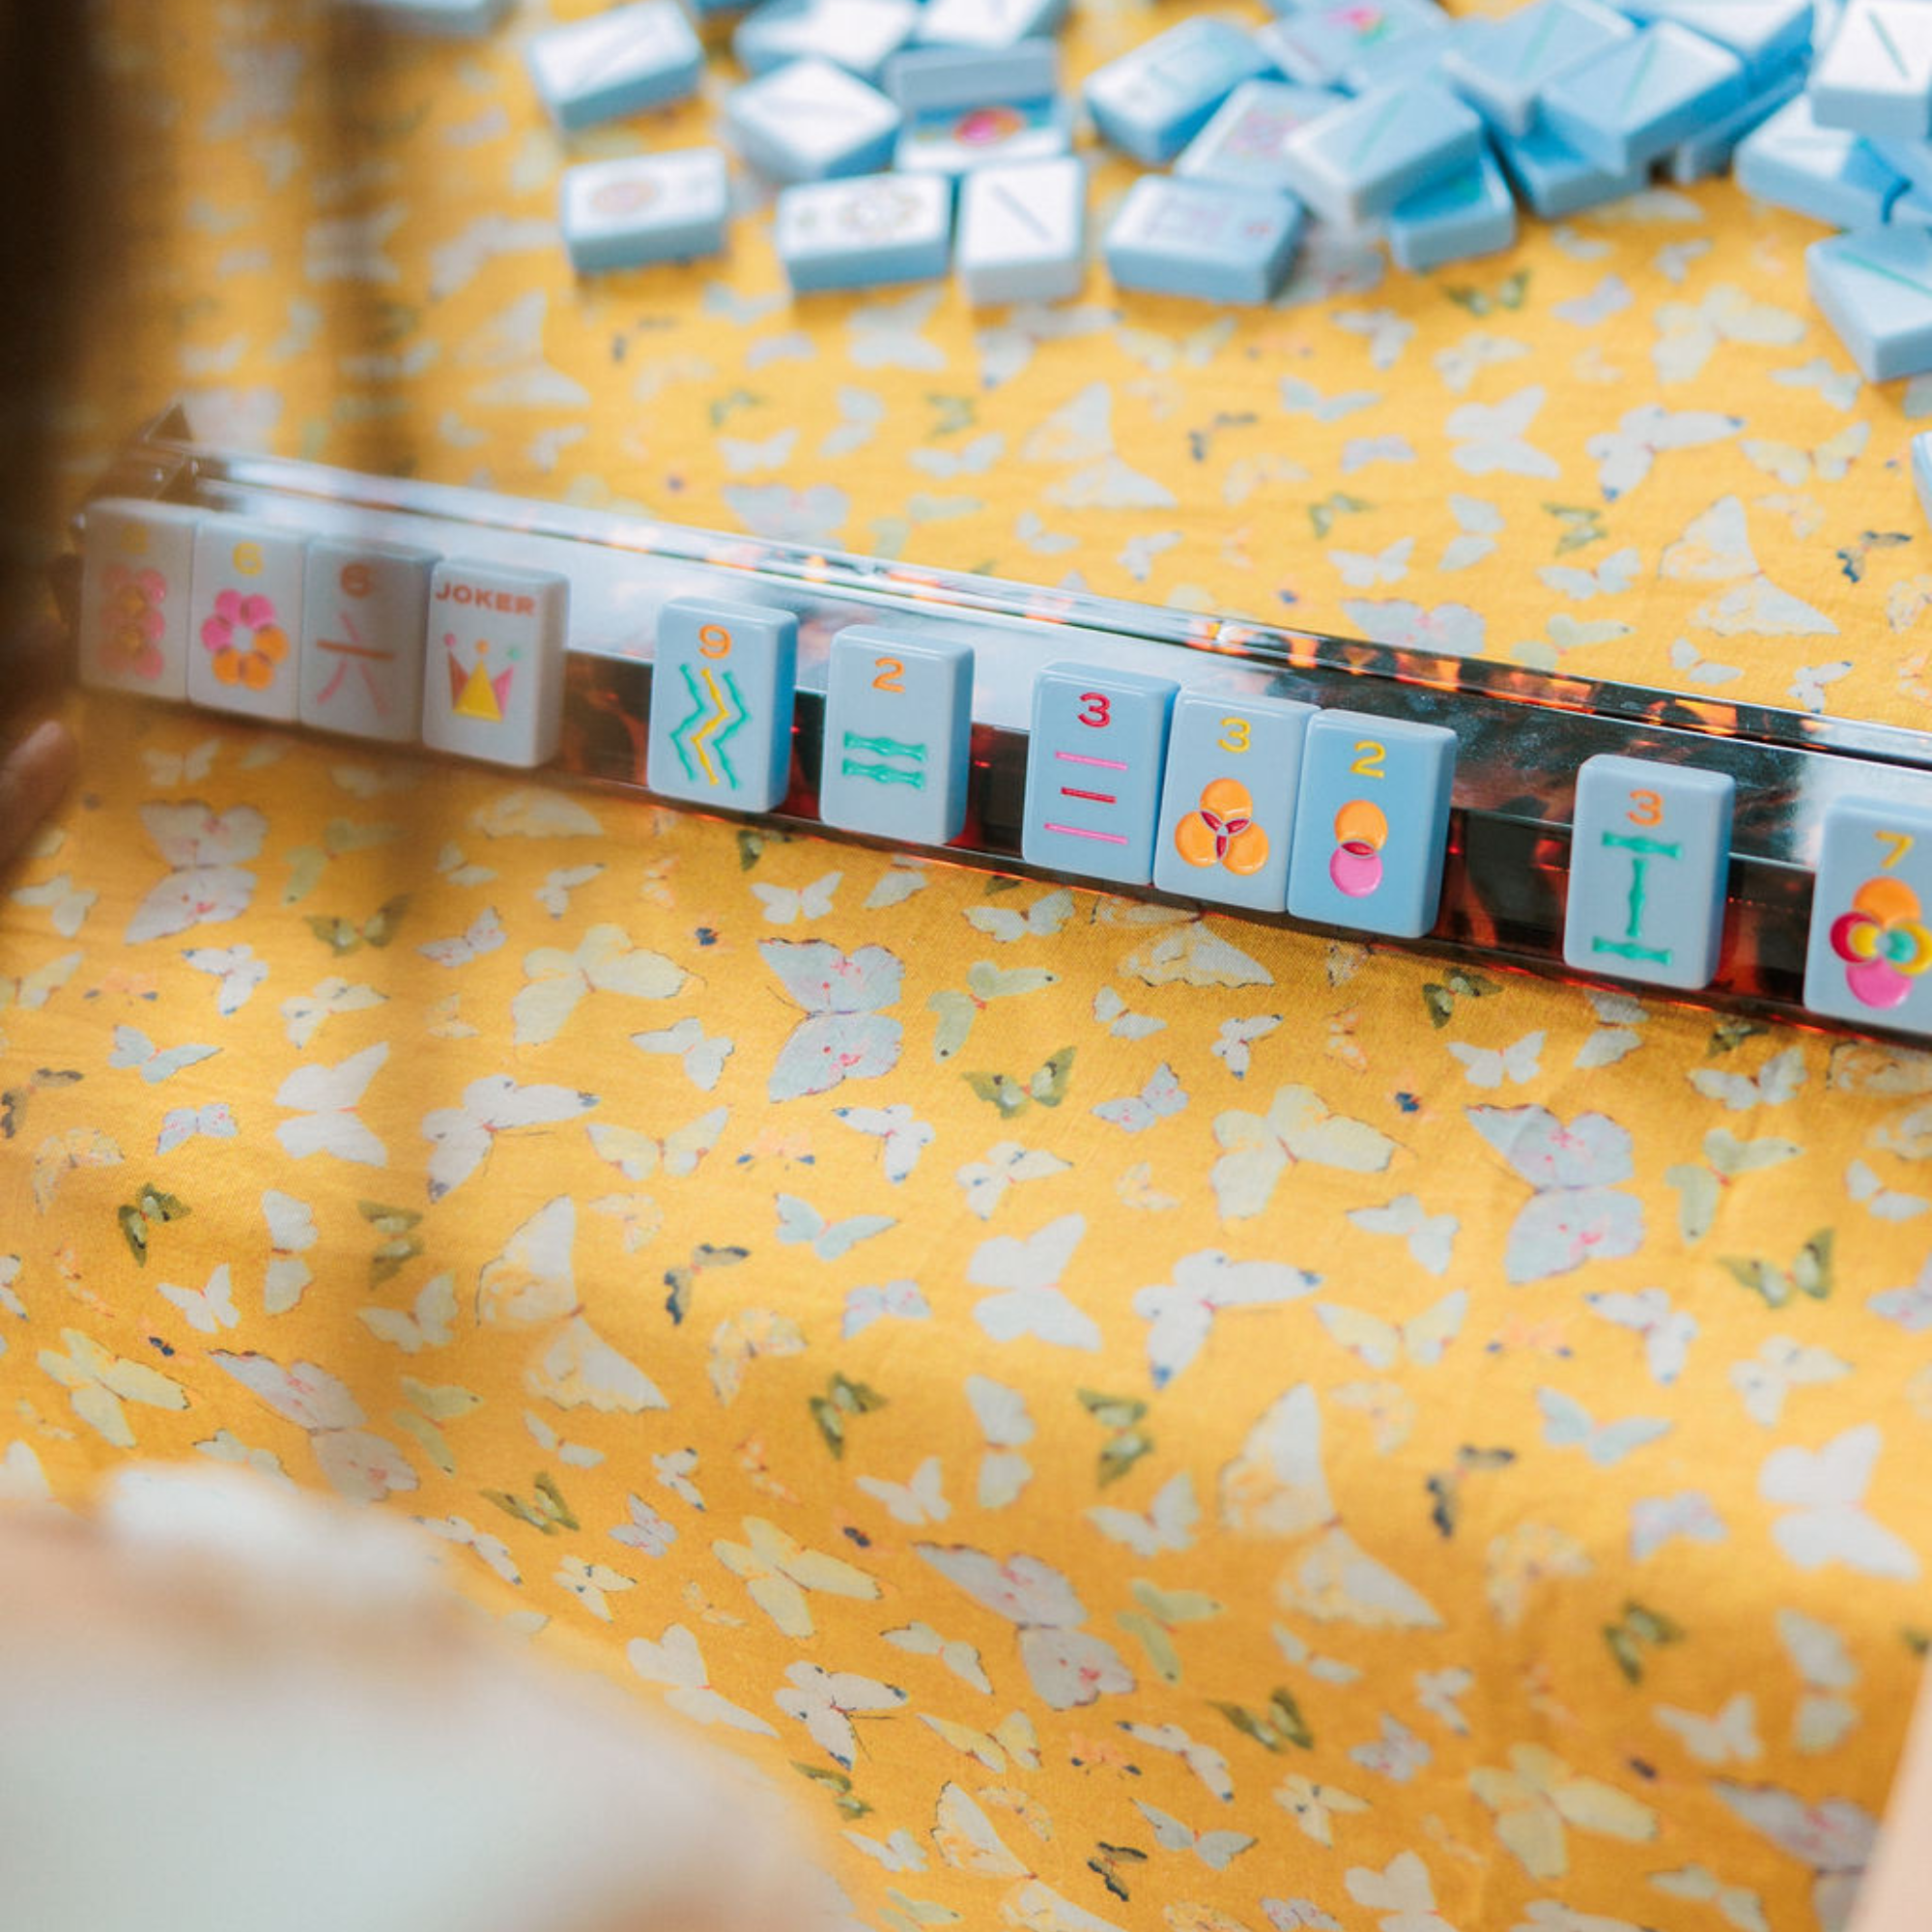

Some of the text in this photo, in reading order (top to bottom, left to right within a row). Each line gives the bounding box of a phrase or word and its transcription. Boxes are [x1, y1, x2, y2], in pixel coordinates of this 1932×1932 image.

[233, 542, 265, 576] 6
[339, 562, 373, 598] 6
[435, 582, 537, 617] JOKER
[698, 624, 732, 660] 9
[872, 657, 906, 694] 2
[1077, 692, 1112, 728] 3
[1217, 717, 1252, 753] 3
[1350, 740, 1387, 779] 2
[1627, 788, 1663, 827] 3
[1874, 830, 1914, 868] 7
